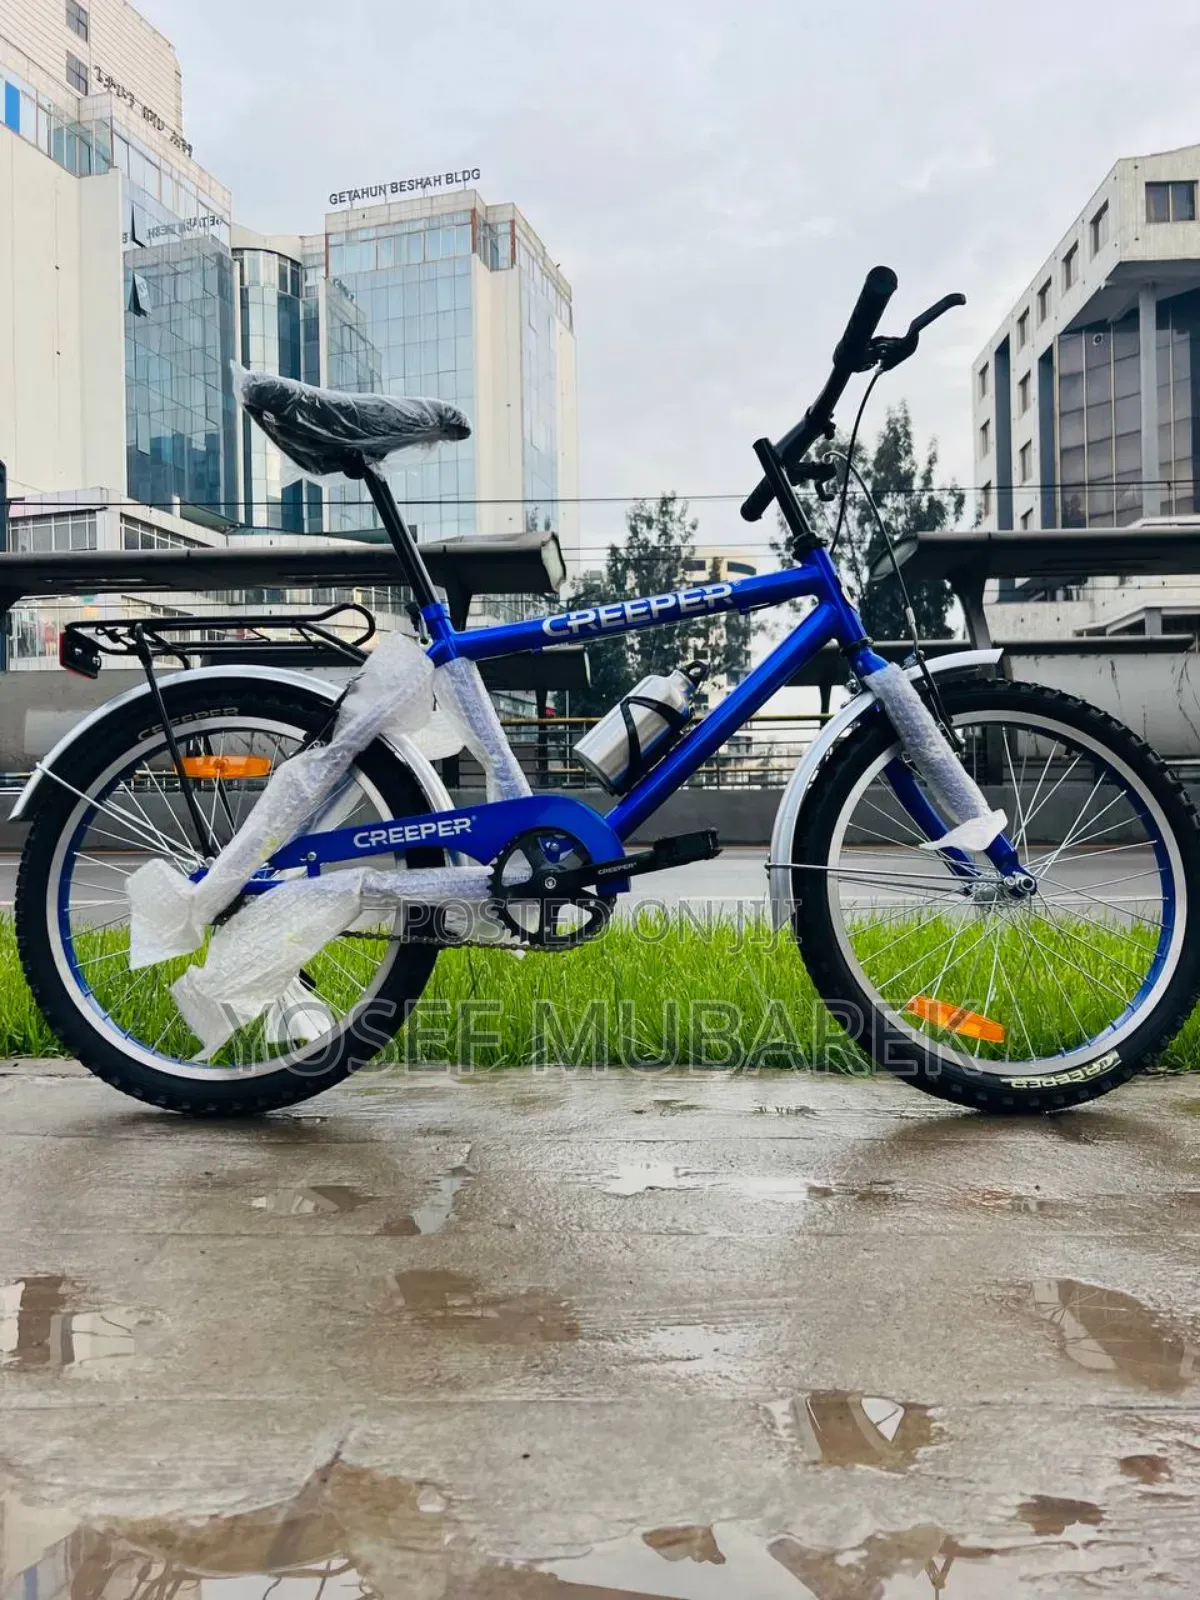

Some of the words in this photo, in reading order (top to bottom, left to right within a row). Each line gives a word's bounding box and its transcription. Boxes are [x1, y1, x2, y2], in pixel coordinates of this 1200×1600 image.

[329, 184, 387, 205] GETAHUN
[390, 174, 442, 194] BESHAH
[445, 168, 481, 185] BLDG
[542, 583, 734, 637] CREEPER
[353, 817, 472, 848] CREEPER
